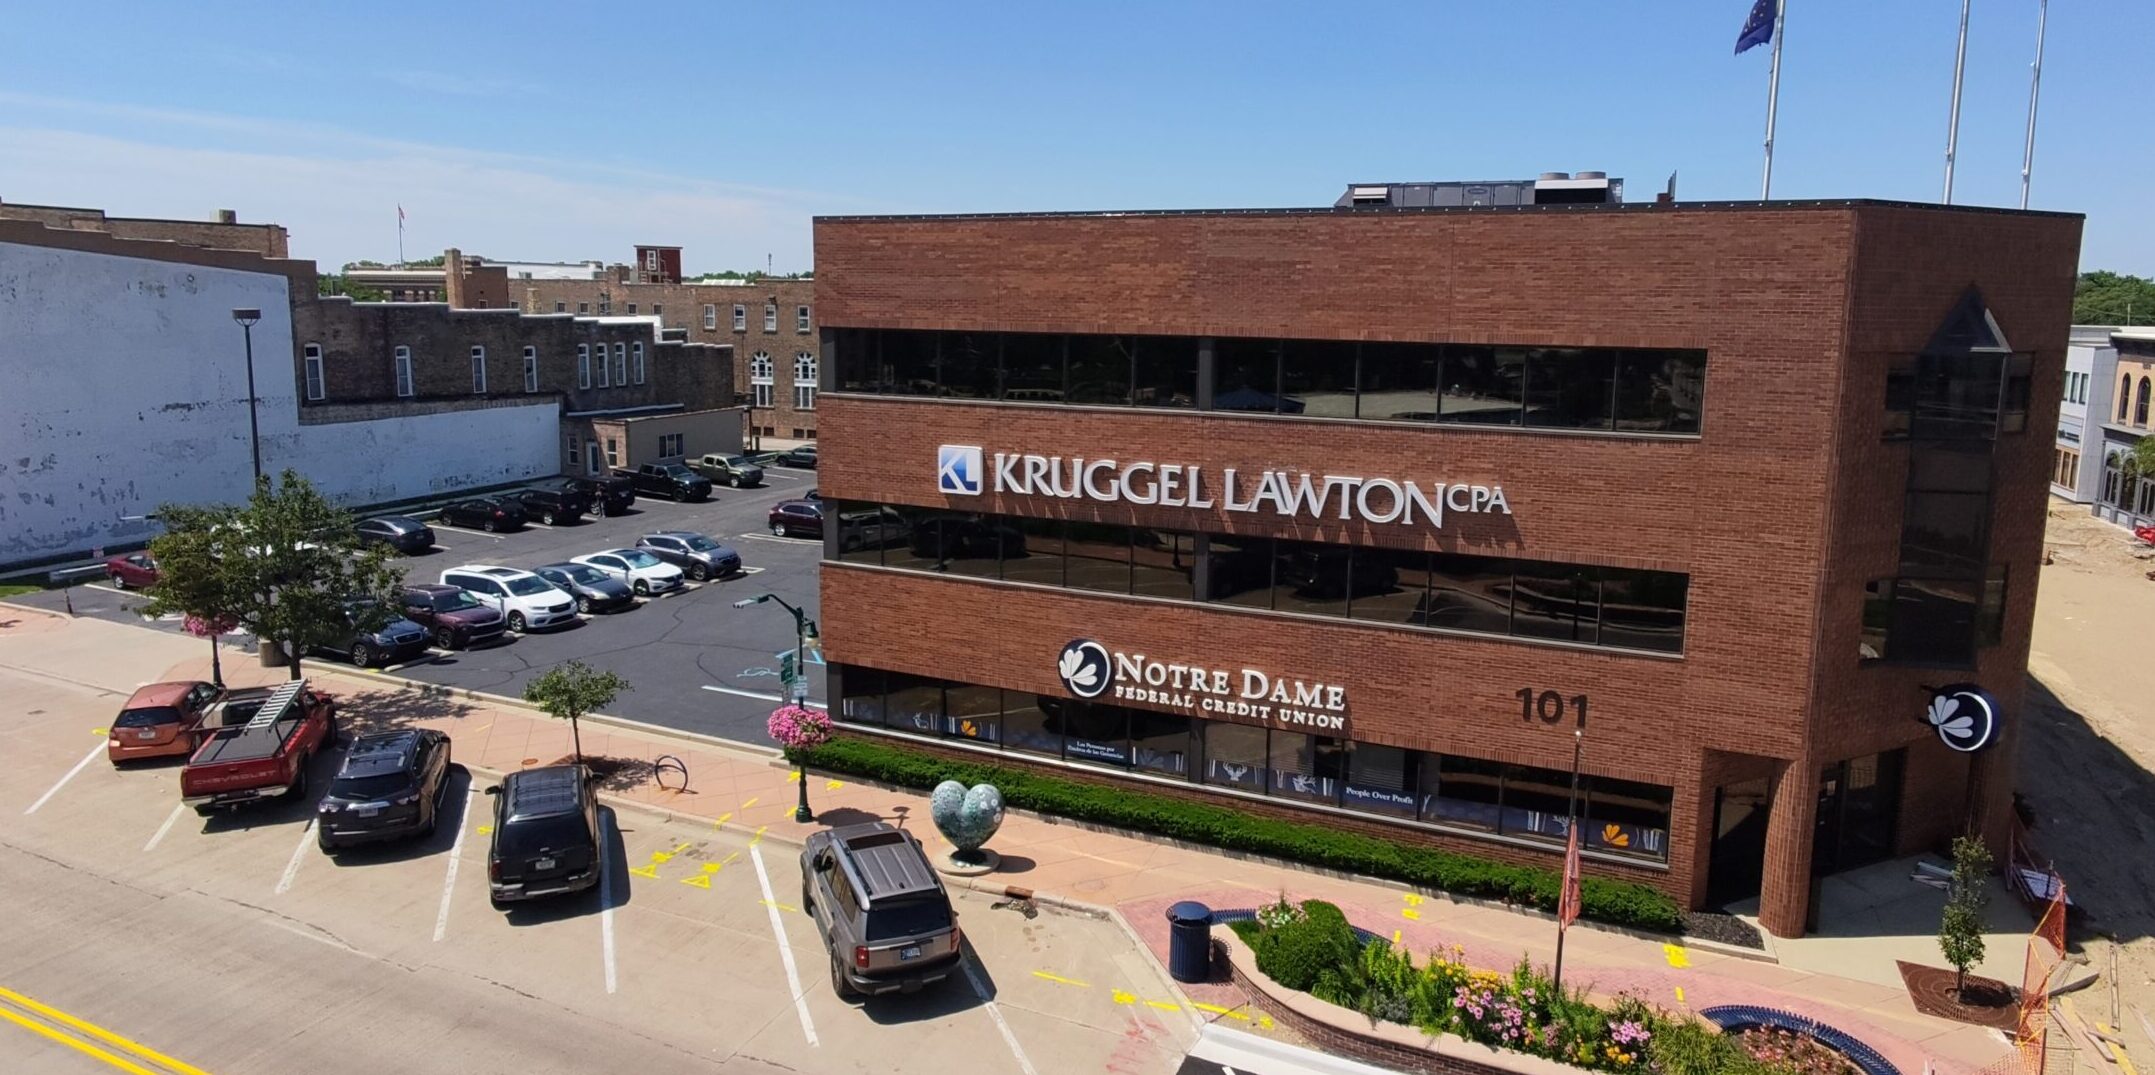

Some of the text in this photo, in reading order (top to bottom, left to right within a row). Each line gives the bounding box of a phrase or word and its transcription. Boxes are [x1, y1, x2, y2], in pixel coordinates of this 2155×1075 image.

[994, 453, 1512, 529] KRUGGEL LAWTON CPA
[1114, 652, 1345, 711] NOTRE DAME
[1115, 685, 1345, 730] FEDERAL CREDIT UNION
[1515, 687, 1588, 729] 101
[1345, 786, 1414, 804] People Over Profit
